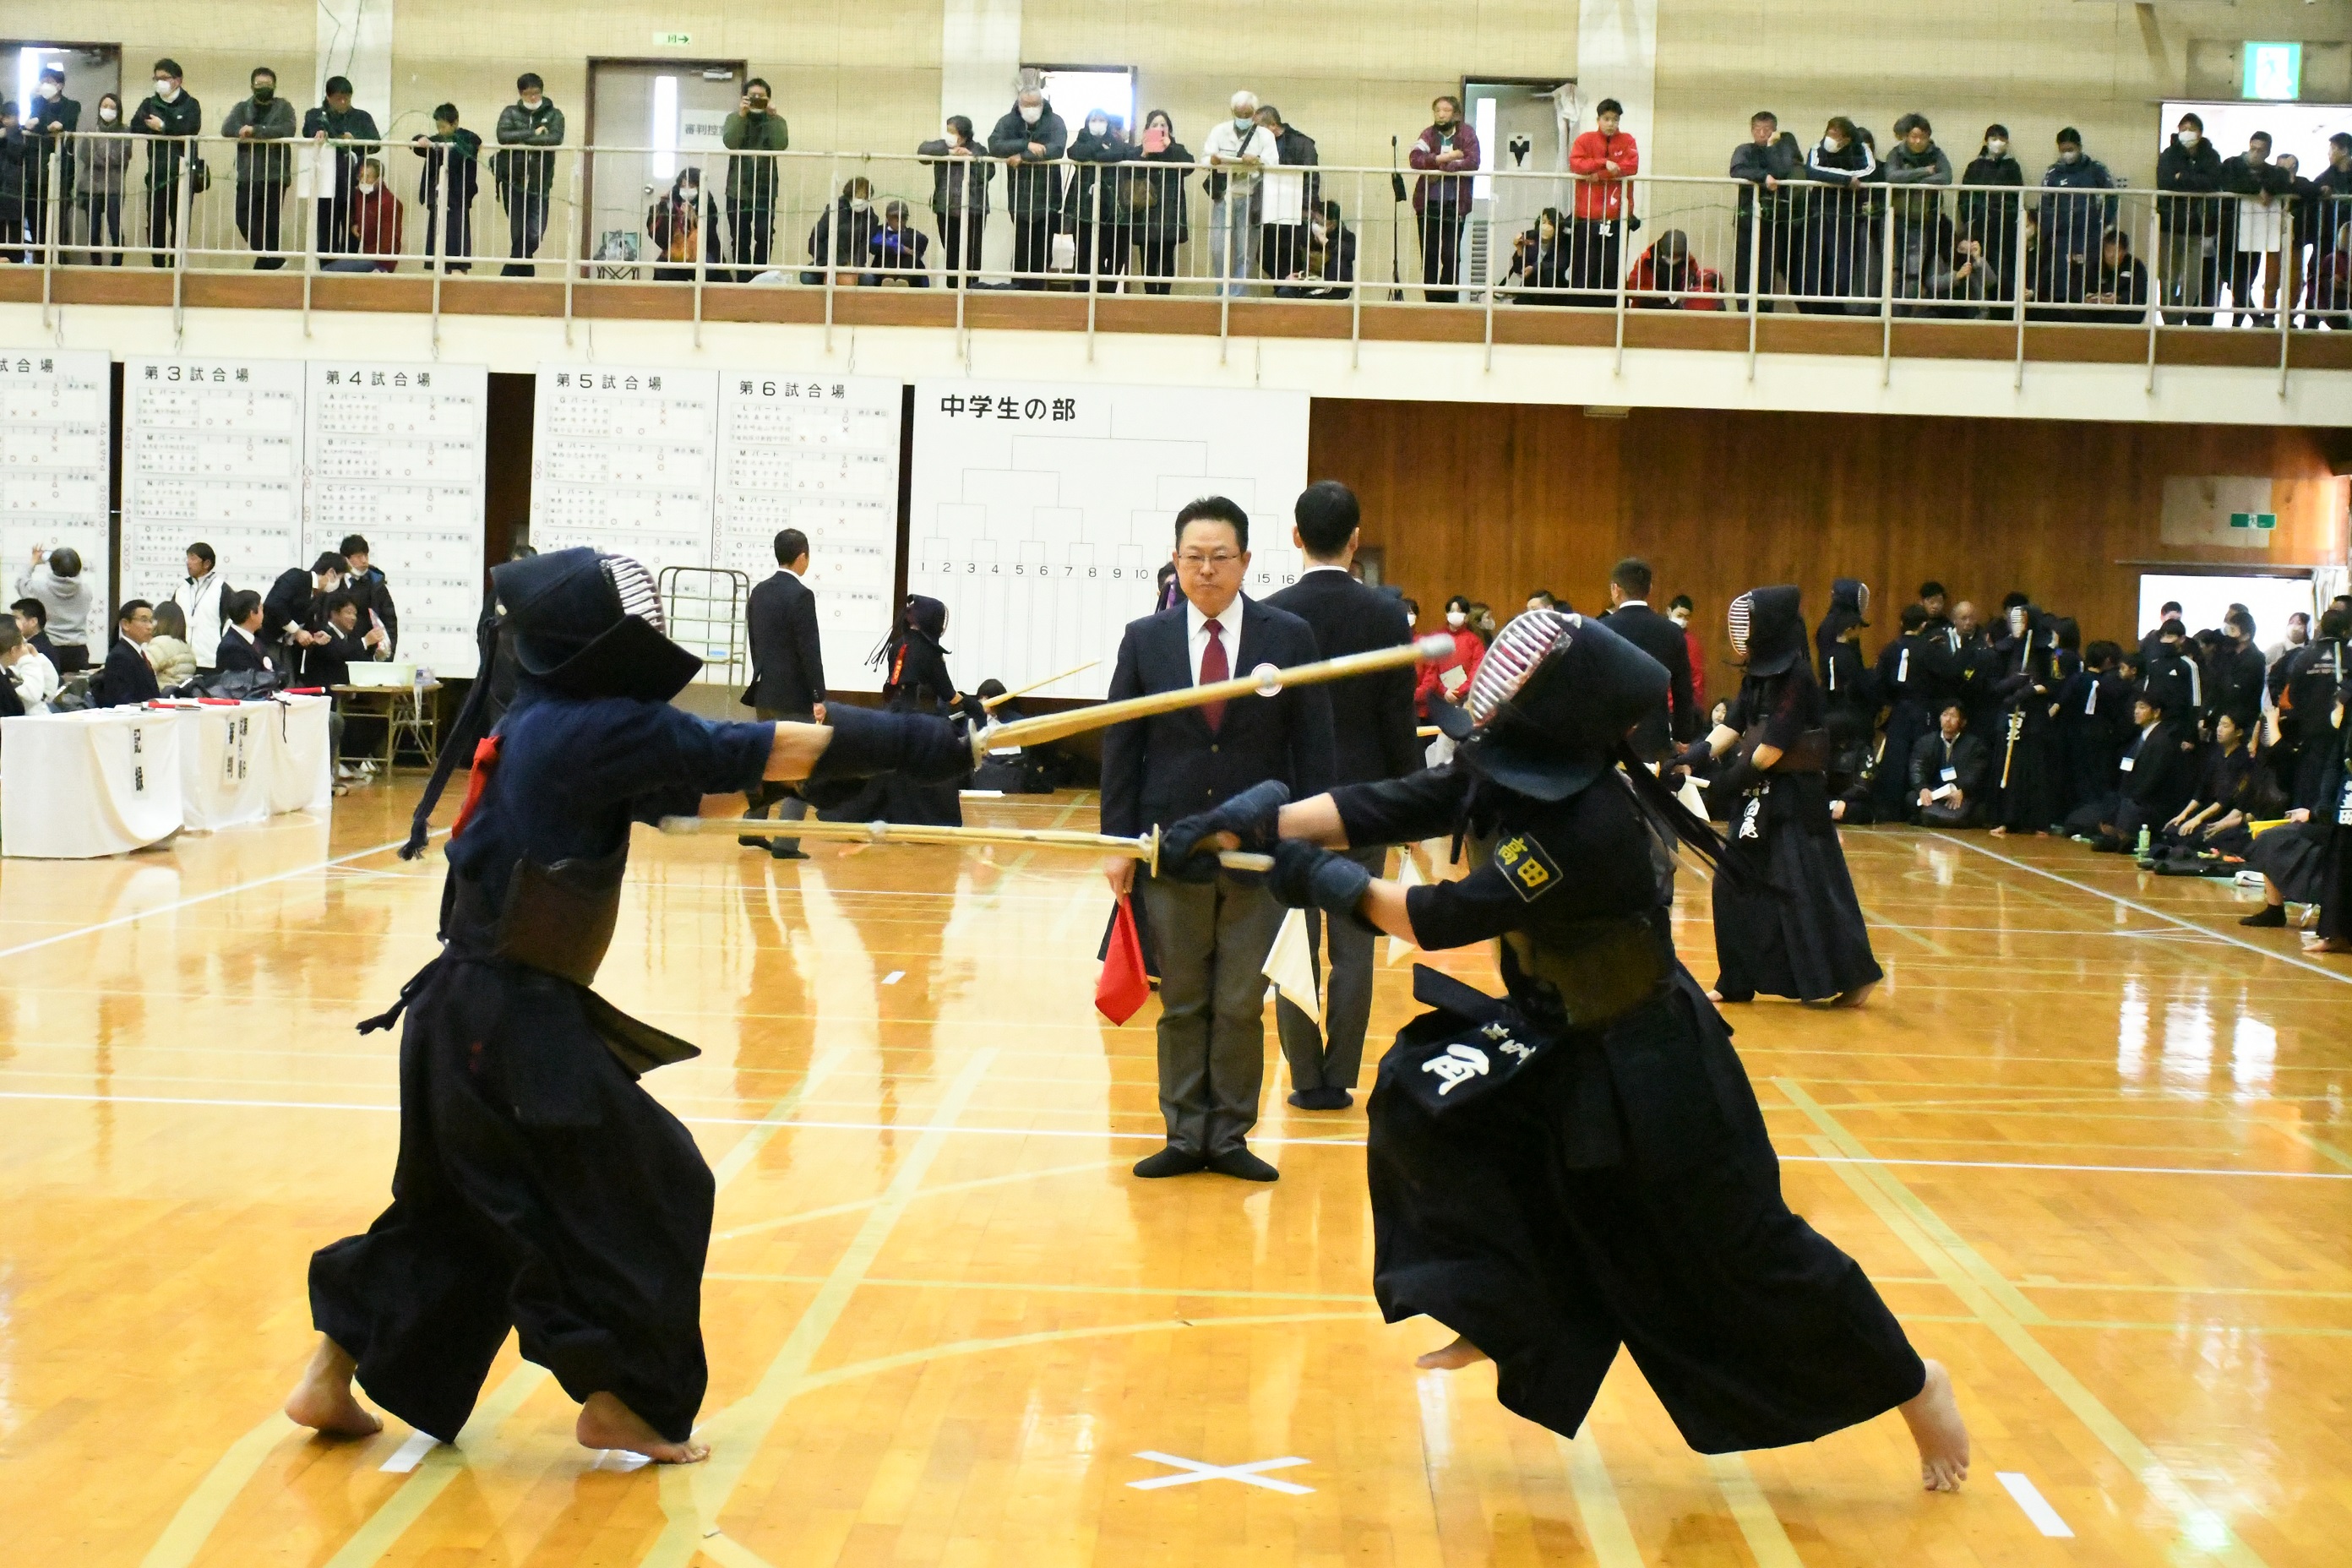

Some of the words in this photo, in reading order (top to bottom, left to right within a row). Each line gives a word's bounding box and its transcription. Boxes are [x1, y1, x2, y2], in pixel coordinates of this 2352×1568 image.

[145, 366, 248, 382] 第3試合場
[326, 370, 431, 387] 第4試合場
[558, 373, 662, 391] 第5試合場
[740, 380, 845, 399] 第6試合場
[941, 395, 1075, 422] 中学生の部
[923, 563, 924, 571] 1
[943, 563, 950, 572] 2
[968, 564, 975, 573] 3
[992, 564, 999, 573] 4
[1016, 565, 1023, 574] 5
[1040, 566, 1048, 575] 6
[1064, 567, 1073, 576] 7
[1089, 568, 1097, 577] 8
[1113, 569, 1121, 578] 9
[1135, 569, 1148, 579] 10
[1258, 574, 1270, 583] 15
[1282, 574, 1296, 585] 16
[1498, 837, 1549, 887] 高田
